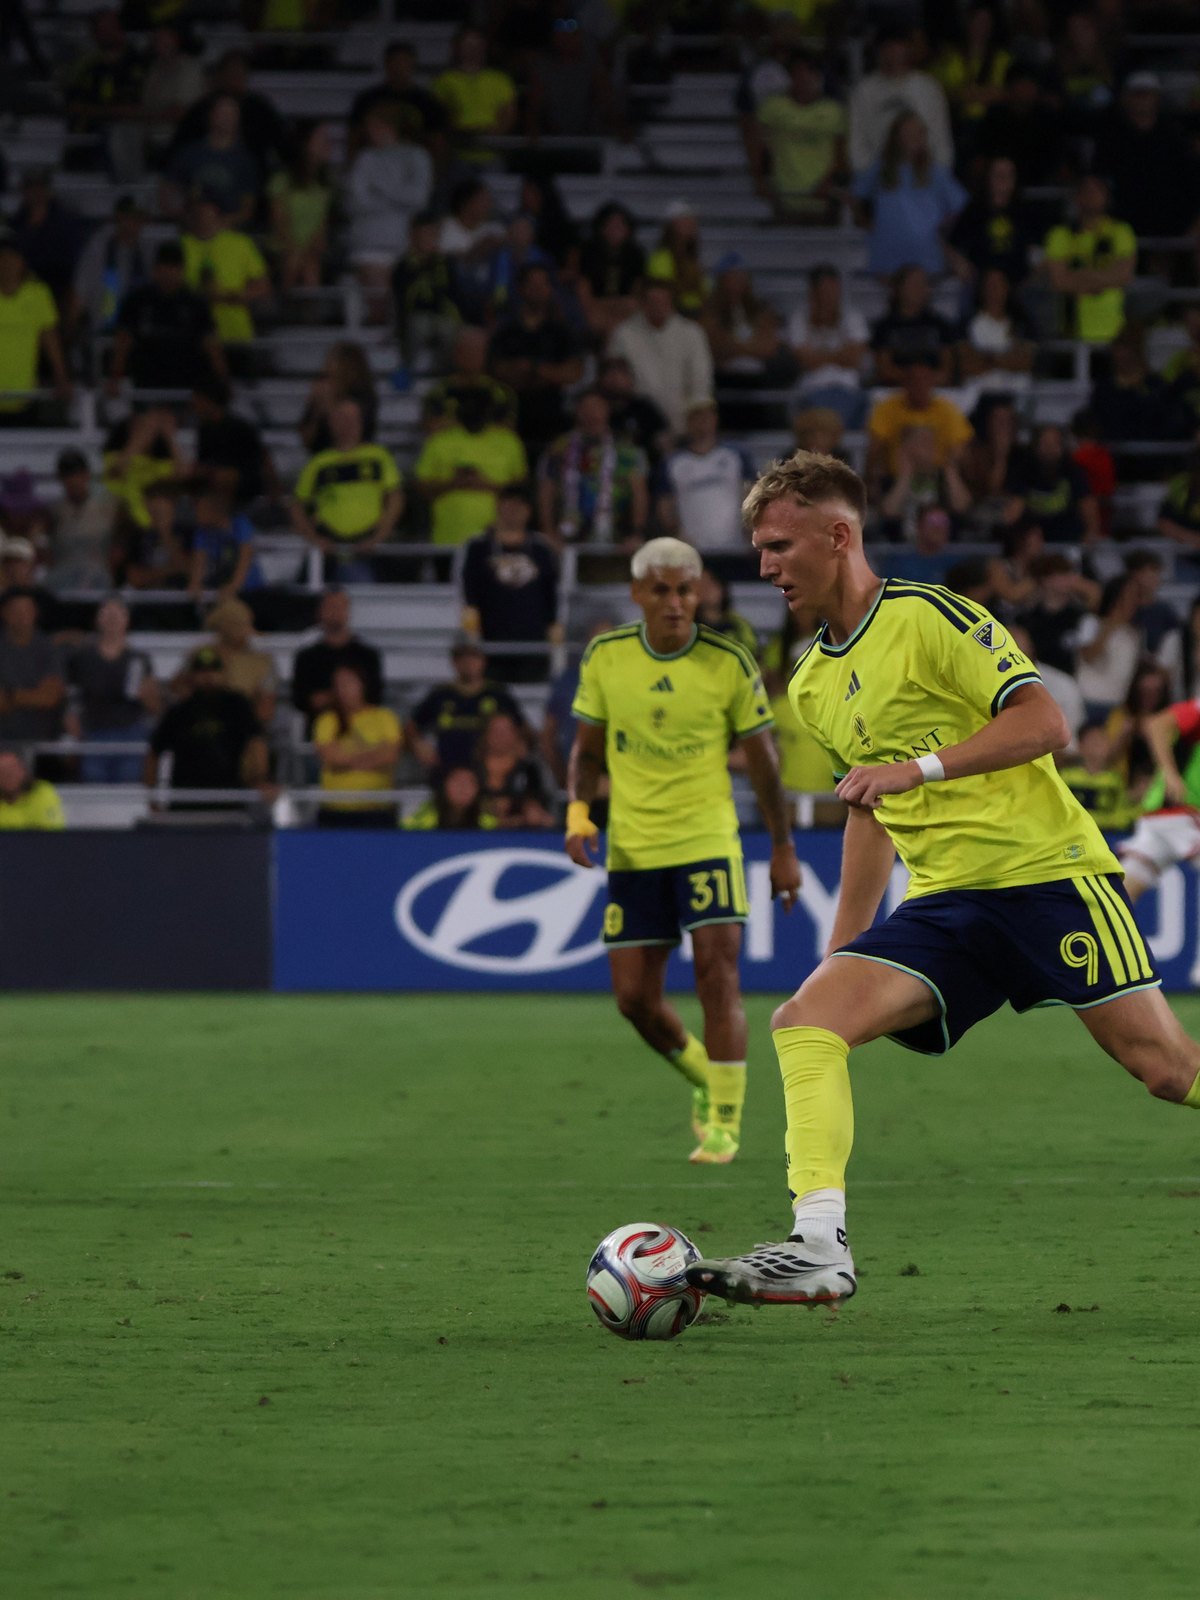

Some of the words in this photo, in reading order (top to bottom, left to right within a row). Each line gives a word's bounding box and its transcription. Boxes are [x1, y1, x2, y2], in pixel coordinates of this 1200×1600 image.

[976, 626, 992, 640] MLS
[689, 868, 730, 912] 31
[1059, 930, 1099, 987] 9
